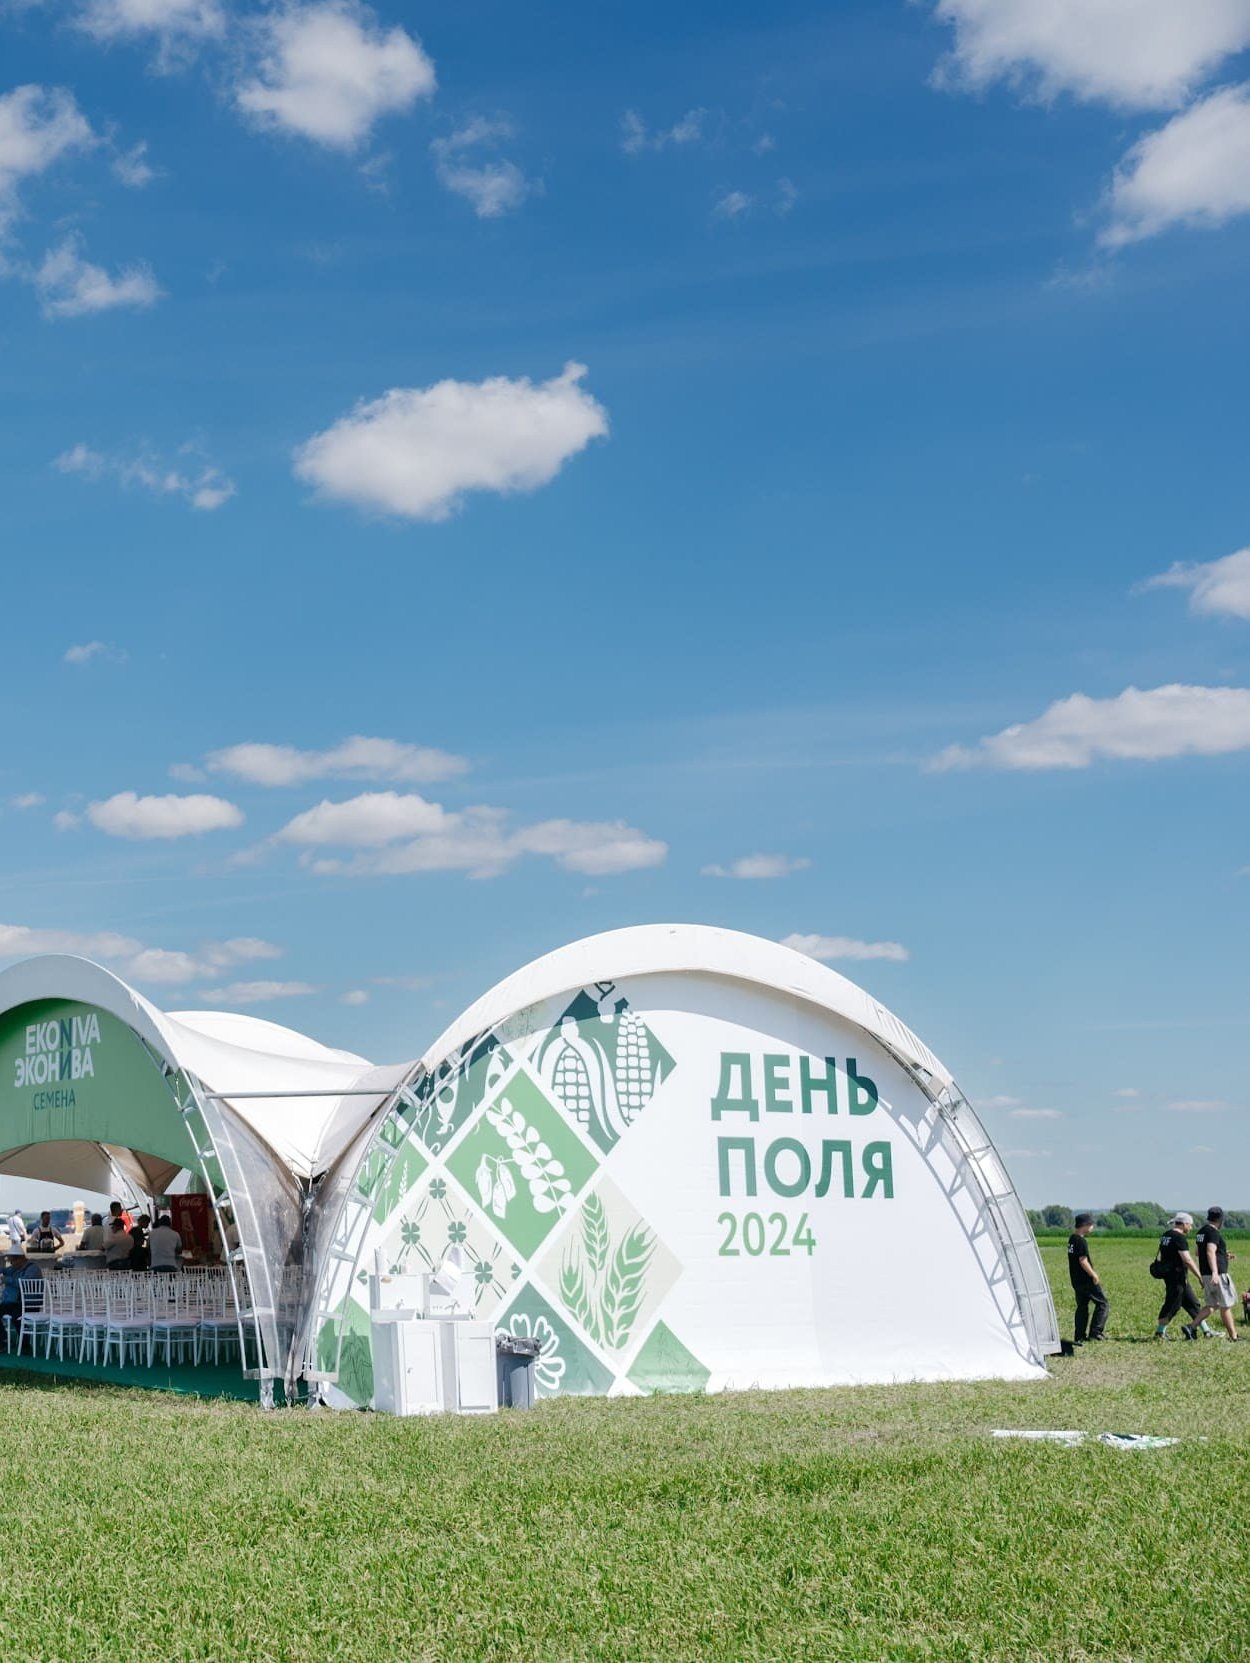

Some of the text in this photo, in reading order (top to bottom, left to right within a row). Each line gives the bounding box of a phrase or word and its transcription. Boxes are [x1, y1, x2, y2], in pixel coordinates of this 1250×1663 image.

[25, 1013, 101, 1055] EKONIVA
[13, 1046, 95, 1088] ЭКОНИВА
[710, 1051, 879, 1122] ДЕНЬ
[33, 1088, 76, 1110] СЕМЕНА
[717, 1136, 895, 1199] ПОЛЯ
[717, 1211, 817, 1256] 2024
